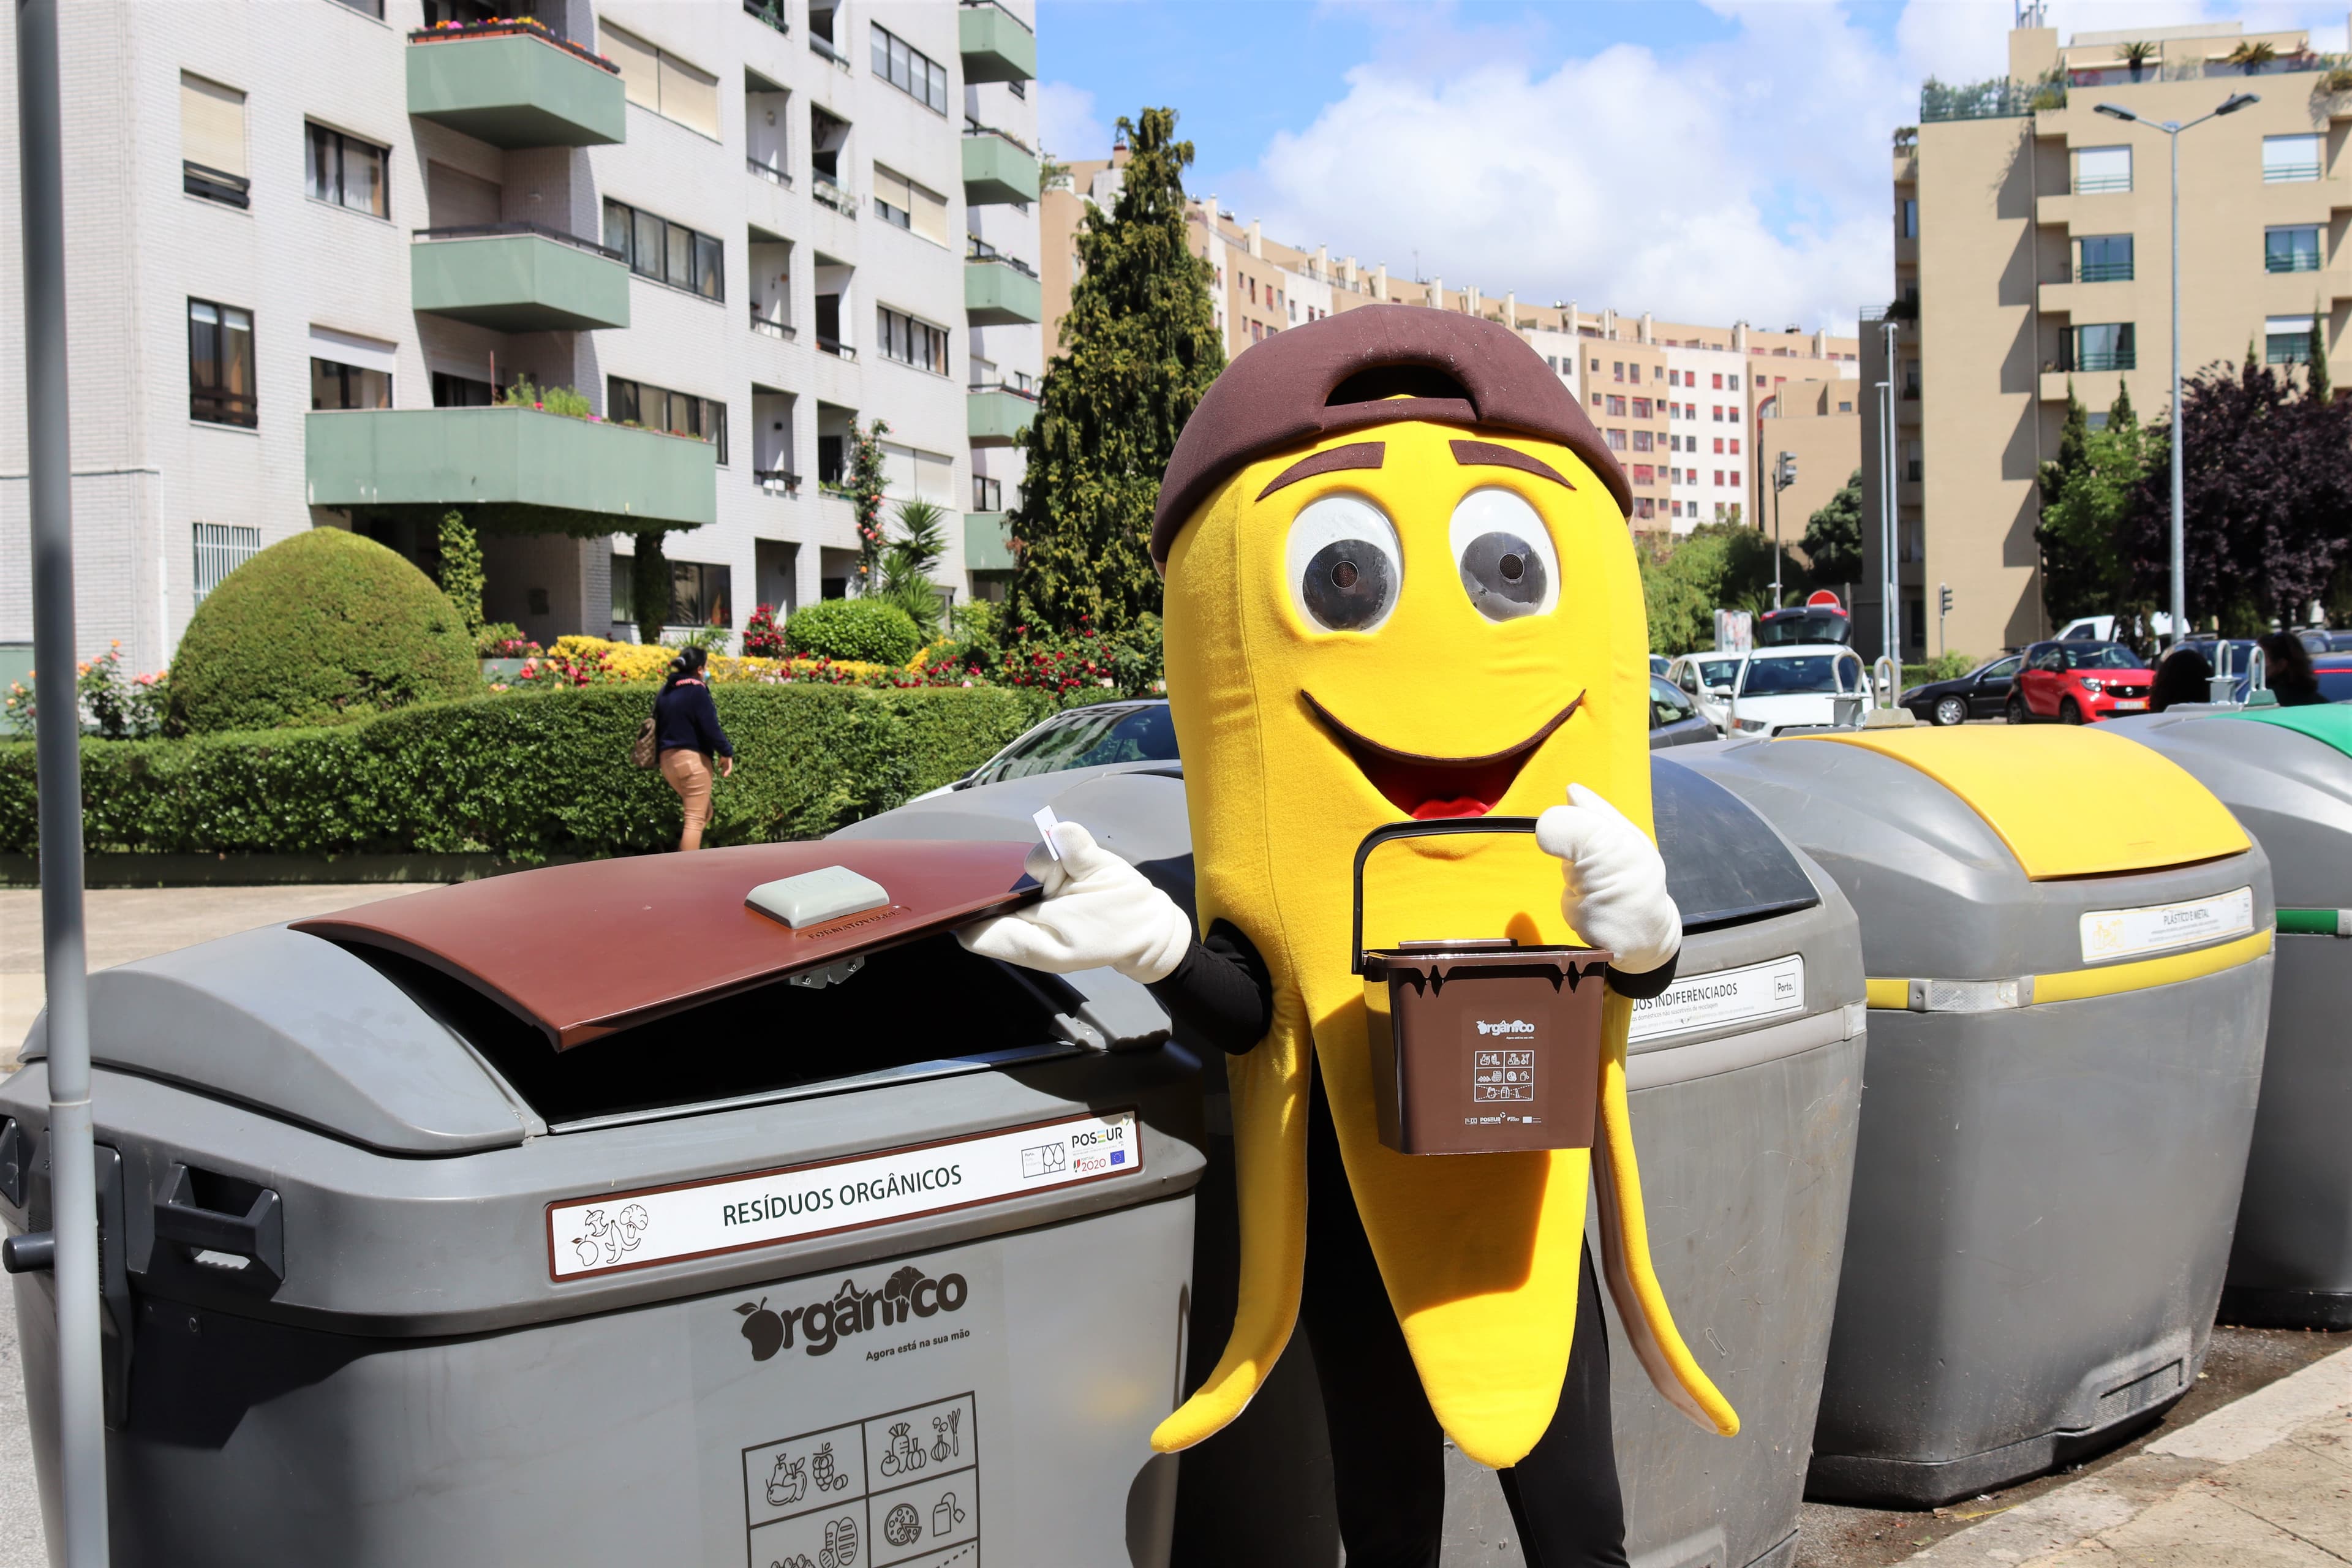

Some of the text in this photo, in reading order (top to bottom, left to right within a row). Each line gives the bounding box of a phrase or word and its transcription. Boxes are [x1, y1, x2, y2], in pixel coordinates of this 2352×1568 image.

[1655, 983, 1738, 1008] INDIFERENCIADOS
[1072, 1127, 1123, 1148] POSEUR
[1082, 1158, 1106, 1172] 2020
[723, 1165, 962, 1226] RESÍDUOS ORGÂNICOS
[866, 1329, 970, 1361] Agora está na sua mão
